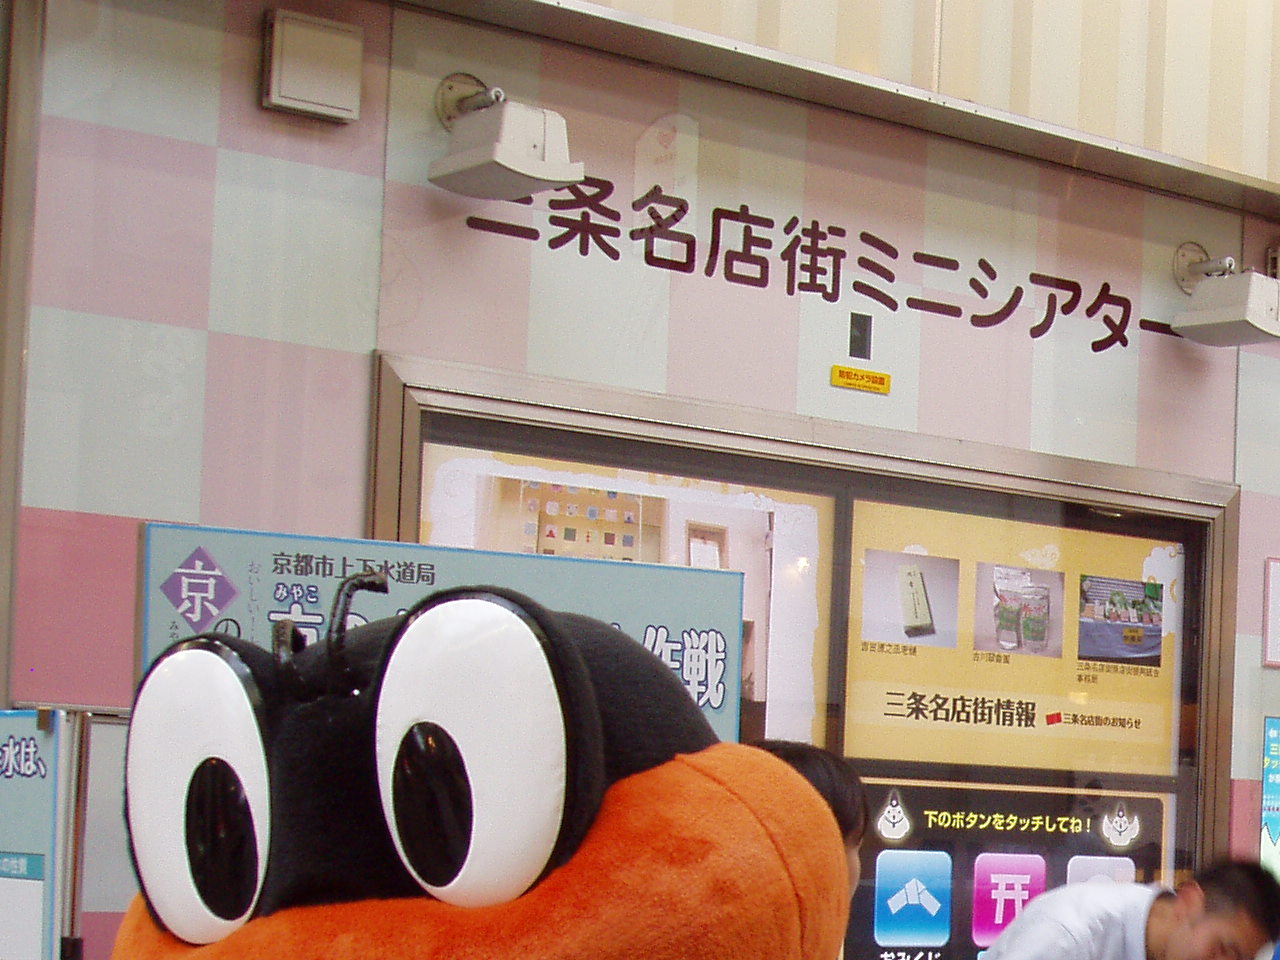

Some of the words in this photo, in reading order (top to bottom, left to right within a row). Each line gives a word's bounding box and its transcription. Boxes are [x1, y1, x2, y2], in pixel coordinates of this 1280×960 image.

[271, 552, 436, 586] 京都市上下水道局
[174, 560, 223, 622] 京
[273, 582, 320, 602] みやこ
[884, 691, 1037, 729] 三条名店街情報
[1063, 712, 1142, 730] 三条名店街のお知らせ
[923, 809, 1092, 834] 下のボタンをタッチしてね！
